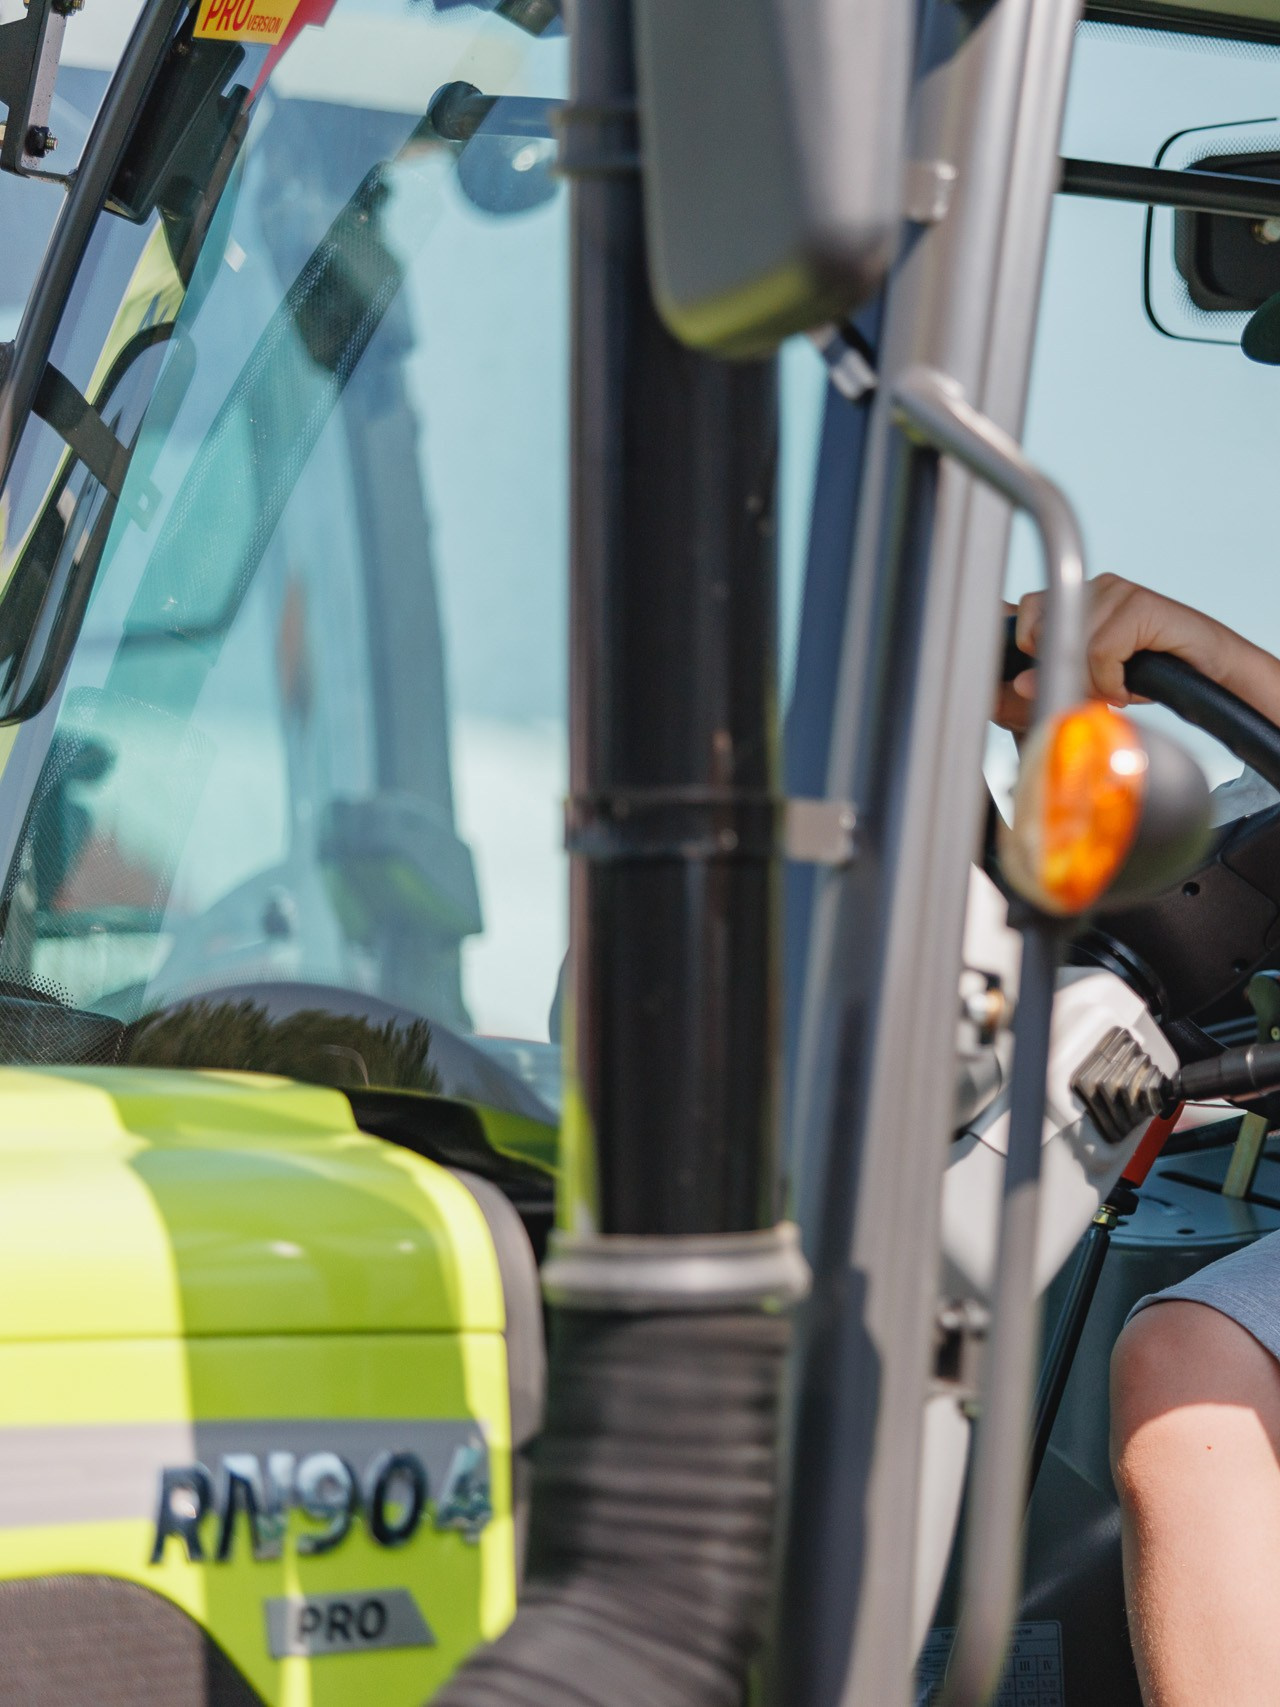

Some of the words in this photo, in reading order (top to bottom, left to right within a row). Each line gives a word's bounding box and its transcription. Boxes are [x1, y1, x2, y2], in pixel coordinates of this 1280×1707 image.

[202, 0, 255, 31] PRO
[247, 15, 283, 34] VERSION
[149, 1440, 494, 1565] RN904
[295, 1599, 388, 1641] PRO
